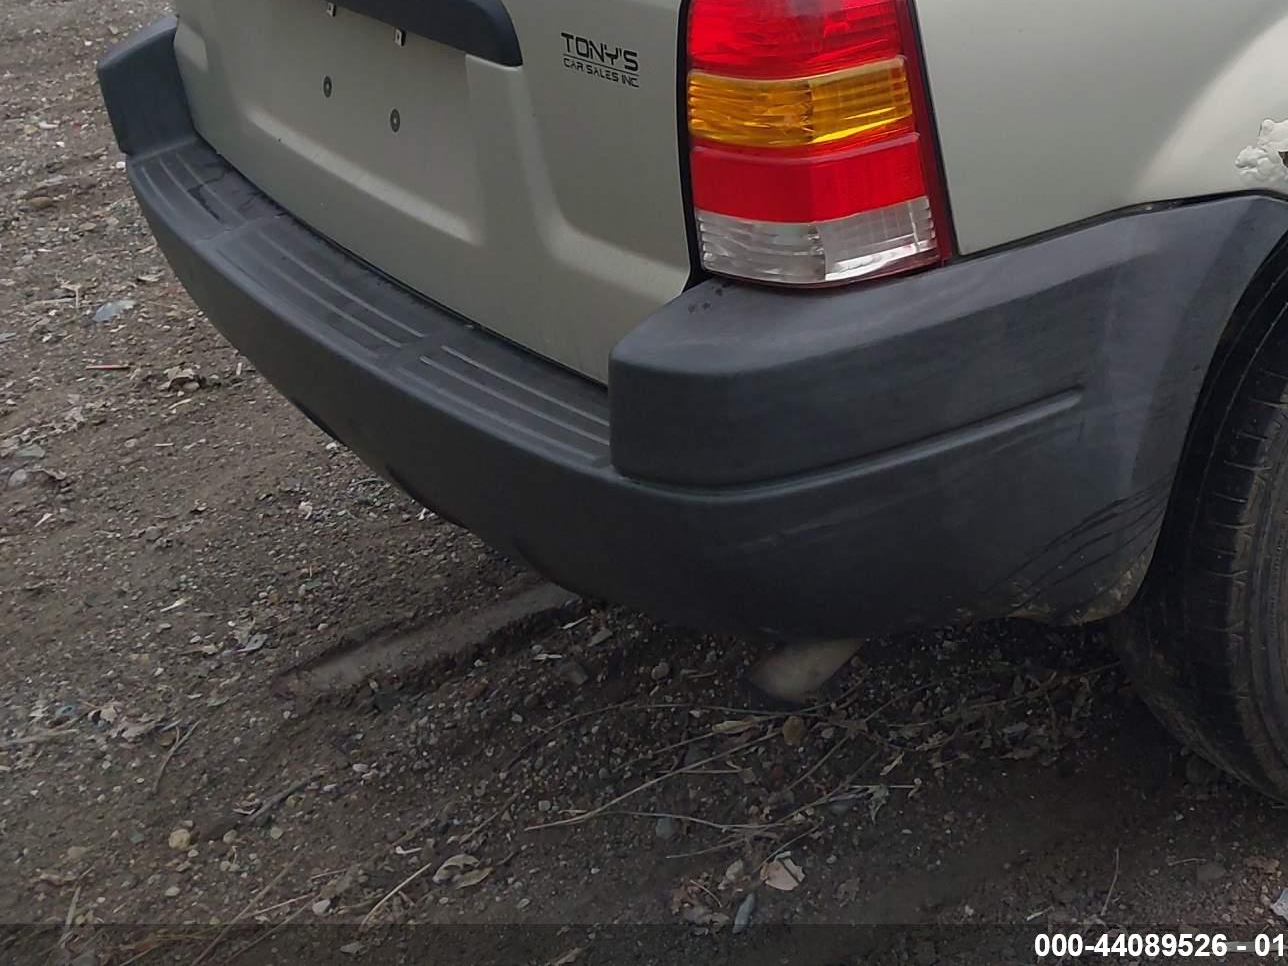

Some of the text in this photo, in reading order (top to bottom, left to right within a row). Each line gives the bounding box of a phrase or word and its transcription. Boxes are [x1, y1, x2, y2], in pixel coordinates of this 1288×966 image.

[560, 32, 639, 72] TONY'S
[563, 57, 640, 88] CAR SALES INC
